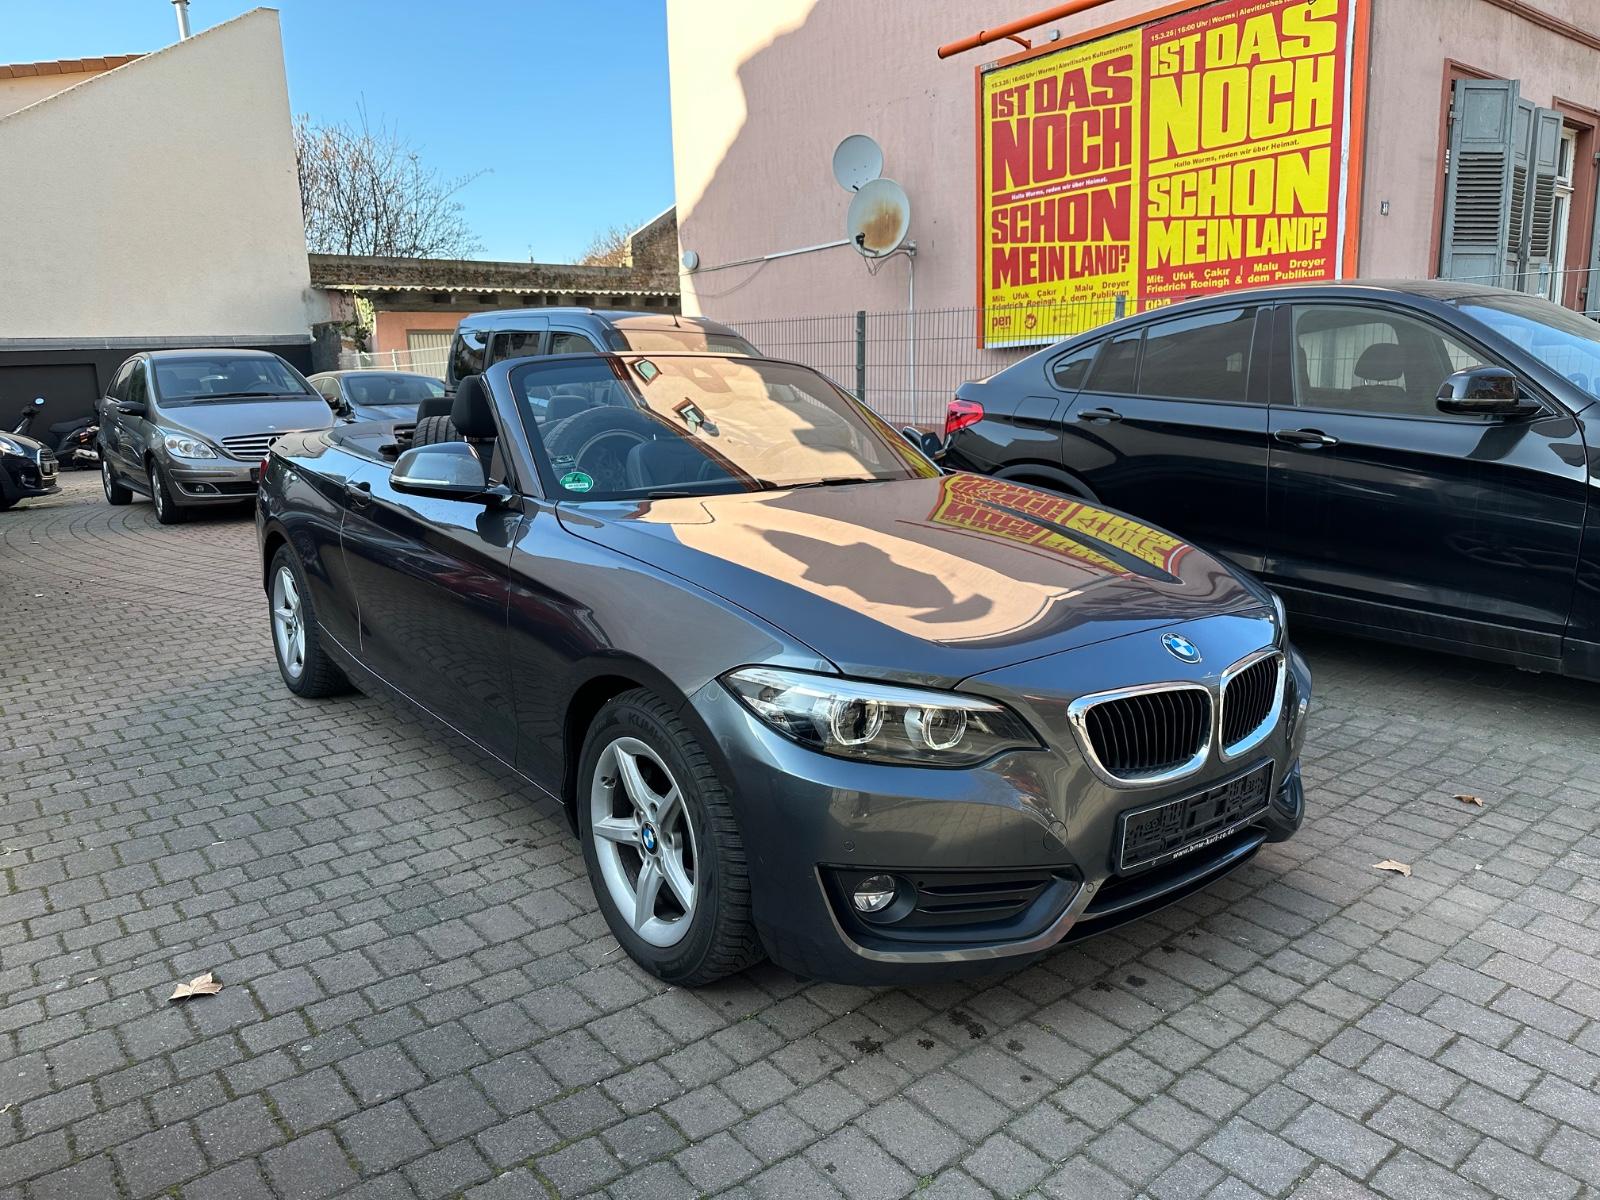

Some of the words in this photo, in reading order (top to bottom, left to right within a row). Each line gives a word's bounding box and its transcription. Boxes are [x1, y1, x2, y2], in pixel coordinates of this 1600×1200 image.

[1196, 20, 1208, 28] Uhr
[1212, 12, 1236, 24] Worms
[1240, 0, 1284, 16] Alevitisches
[1150, 33, 1201, 77] IST
[1205, 0, 1338, 69] DAS
[1038, 66, 1056, 75] Worms
[1058, 56, 1092, 68] Alevitisches
[1092, 43, 1134, 58] Kulturzentrum
[991, 82, 1030, 120] IST
[1033, 54, 1133, 114] DAS
[1149, 55, 1336, 162] NOCH
[992, 105, 1133, 192] NOCH
[1174, 160, 1191, 168] Hallo
[1218, 151, 1238, 160] reden
[1240, 149, 1252, 157] wir
[1271, 140, 1300, 150] Heimat.
[1046, 186, 1060, 194] reden
[1148, 147, 1331, 218] SCHON
[992, 184, 1132, 244] SCHON
[1146, 218, 1242, 270] MEIN
[1246, 217, 1328, 260] LAND?
[992, 246, 1065, 290] MEIN
[1069, 245, 1130, 280] LAND?
[1146, 275, 1164, 284] Mit:
[1172, 272, 1194, 282] Ufuk
[1254, 262, 1278, 272] Malu
[1290, 258, 1326, 270] Dreyer
[1146, 282, 1186, 294] Friedrich
[1191, 278, 1230, 290] Roeingh
[1234, 275, 1242, 284] &
[1248, 272, 1270, 283] dem
[1275, 268, 1325, 281] Publikum
[992, 296, 1006, 304] Mit:
[1012, 292, 1030, 300] Ufuk
[1074, 284, 1094, 292] Malu
[1102, 280, 1130, 290] Dreyer
[1061, 295, 1067, 303] &
[1070, 294, 1088, 302] dem
[1092, 288, 1130, 300] Publikum
[992, 314, 1012, 328] pen
